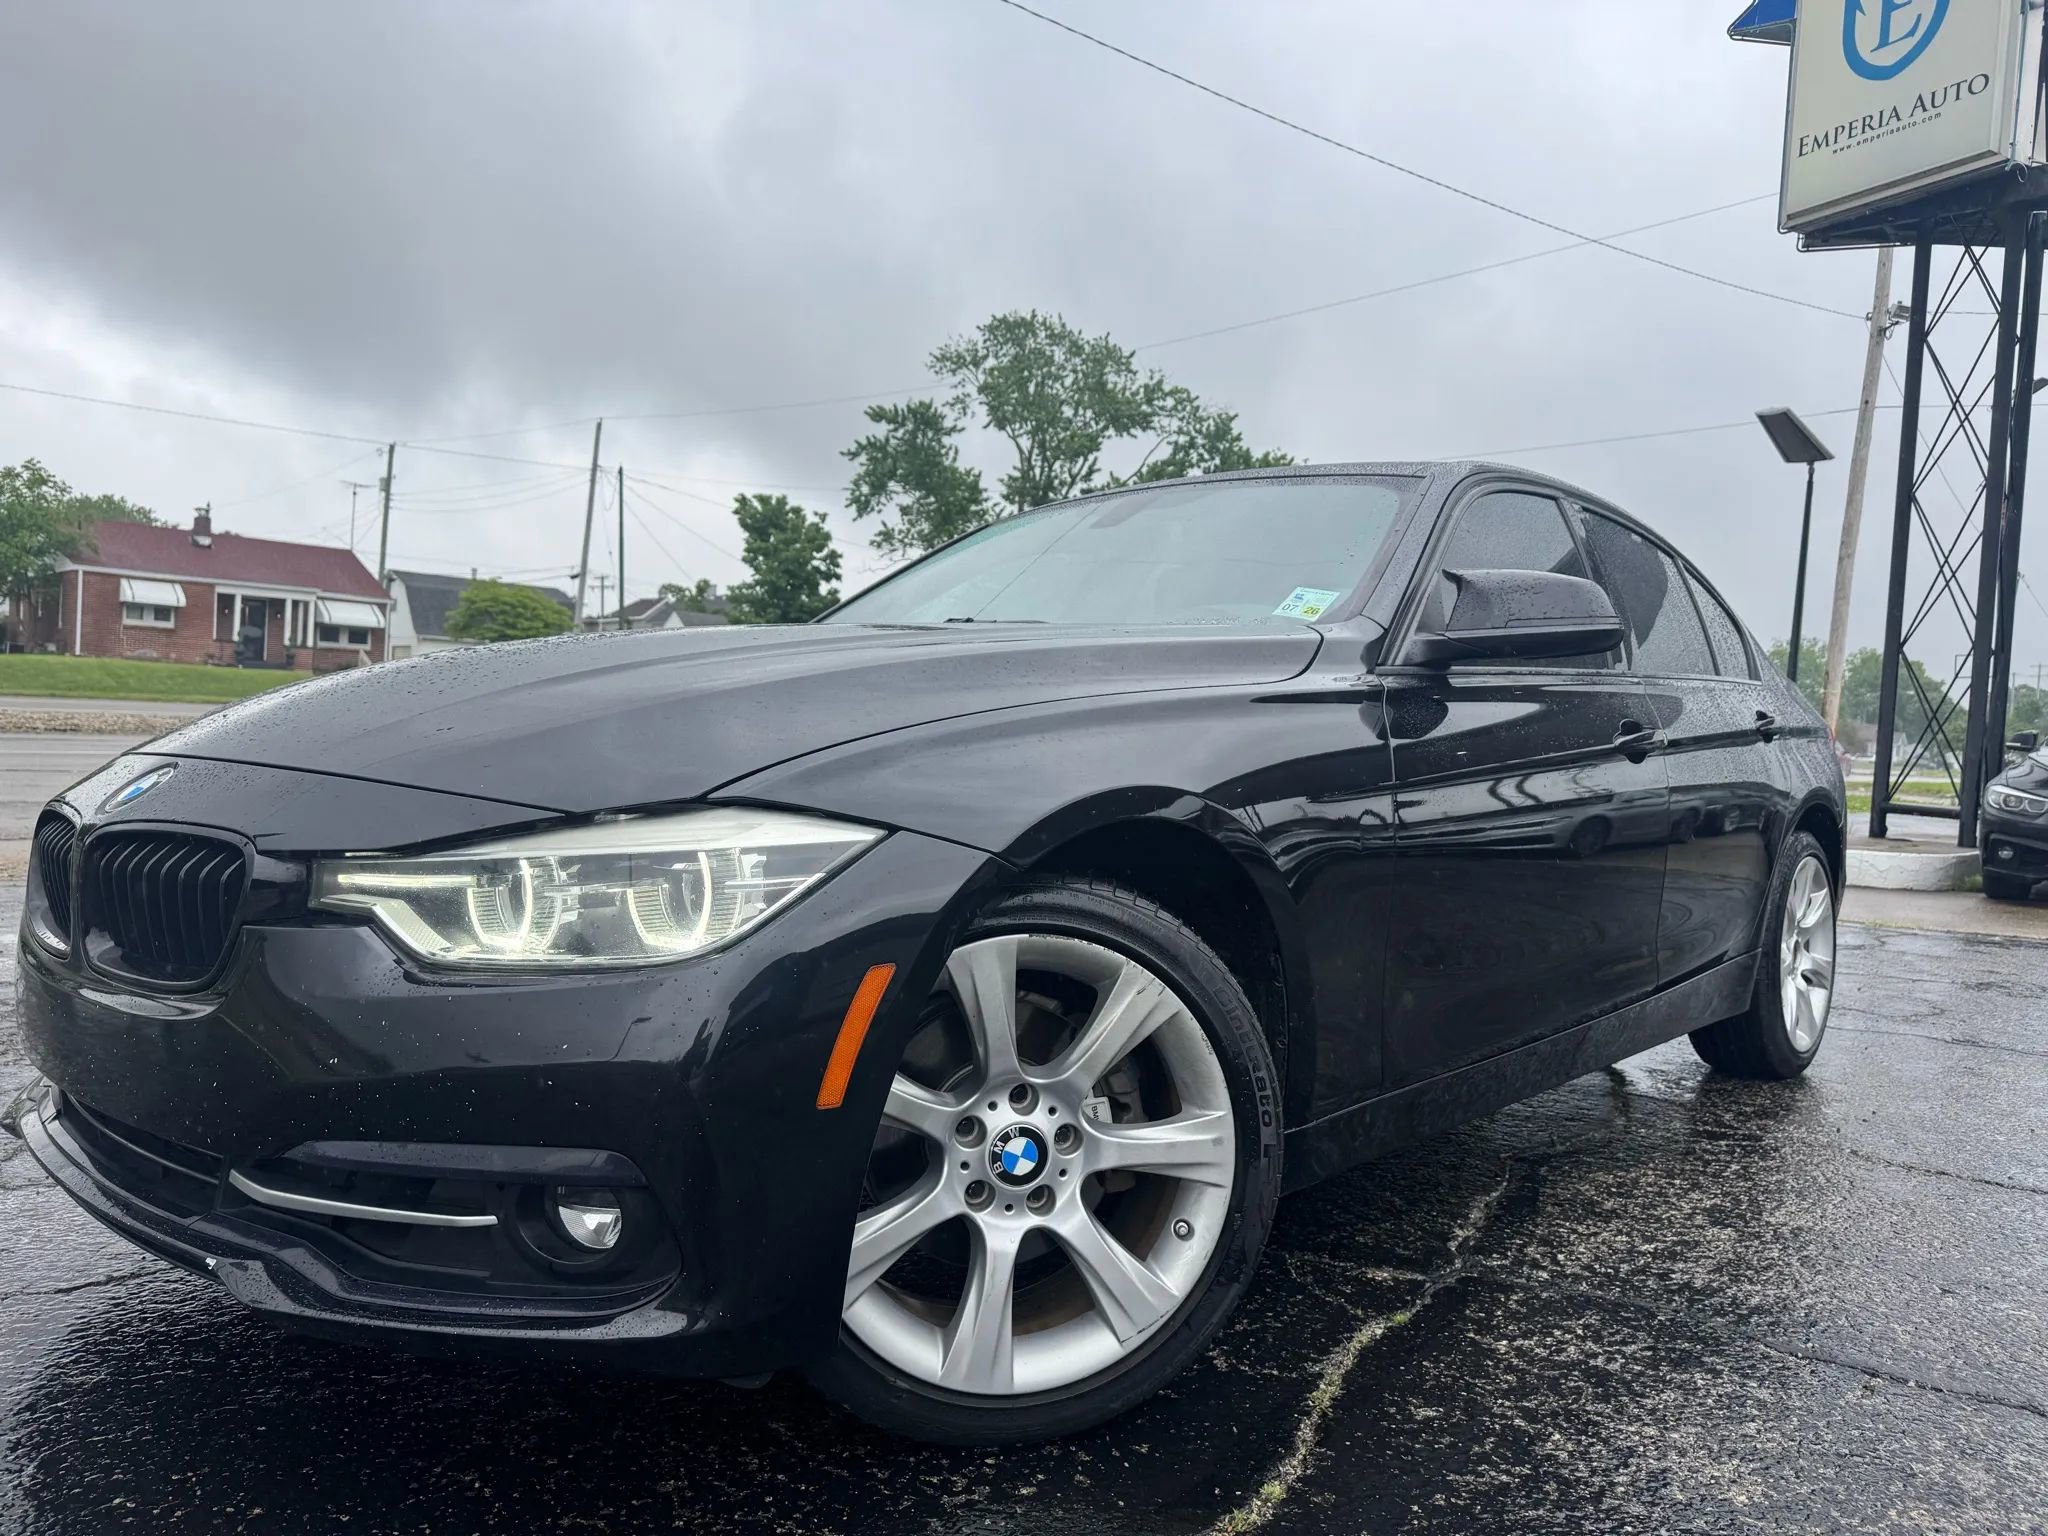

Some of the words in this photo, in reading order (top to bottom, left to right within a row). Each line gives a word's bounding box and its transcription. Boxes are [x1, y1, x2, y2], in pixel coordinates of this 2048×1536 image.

[1797, 104, 1903, 158] EMPERIA
[1908, 73, 1990, 118] AUTO
[1832, 111, 1942, 155] www.emperiaauto.com
[1281, 603, 1299, 612] 07
[992, 1126, 1020, 1174] BMW
